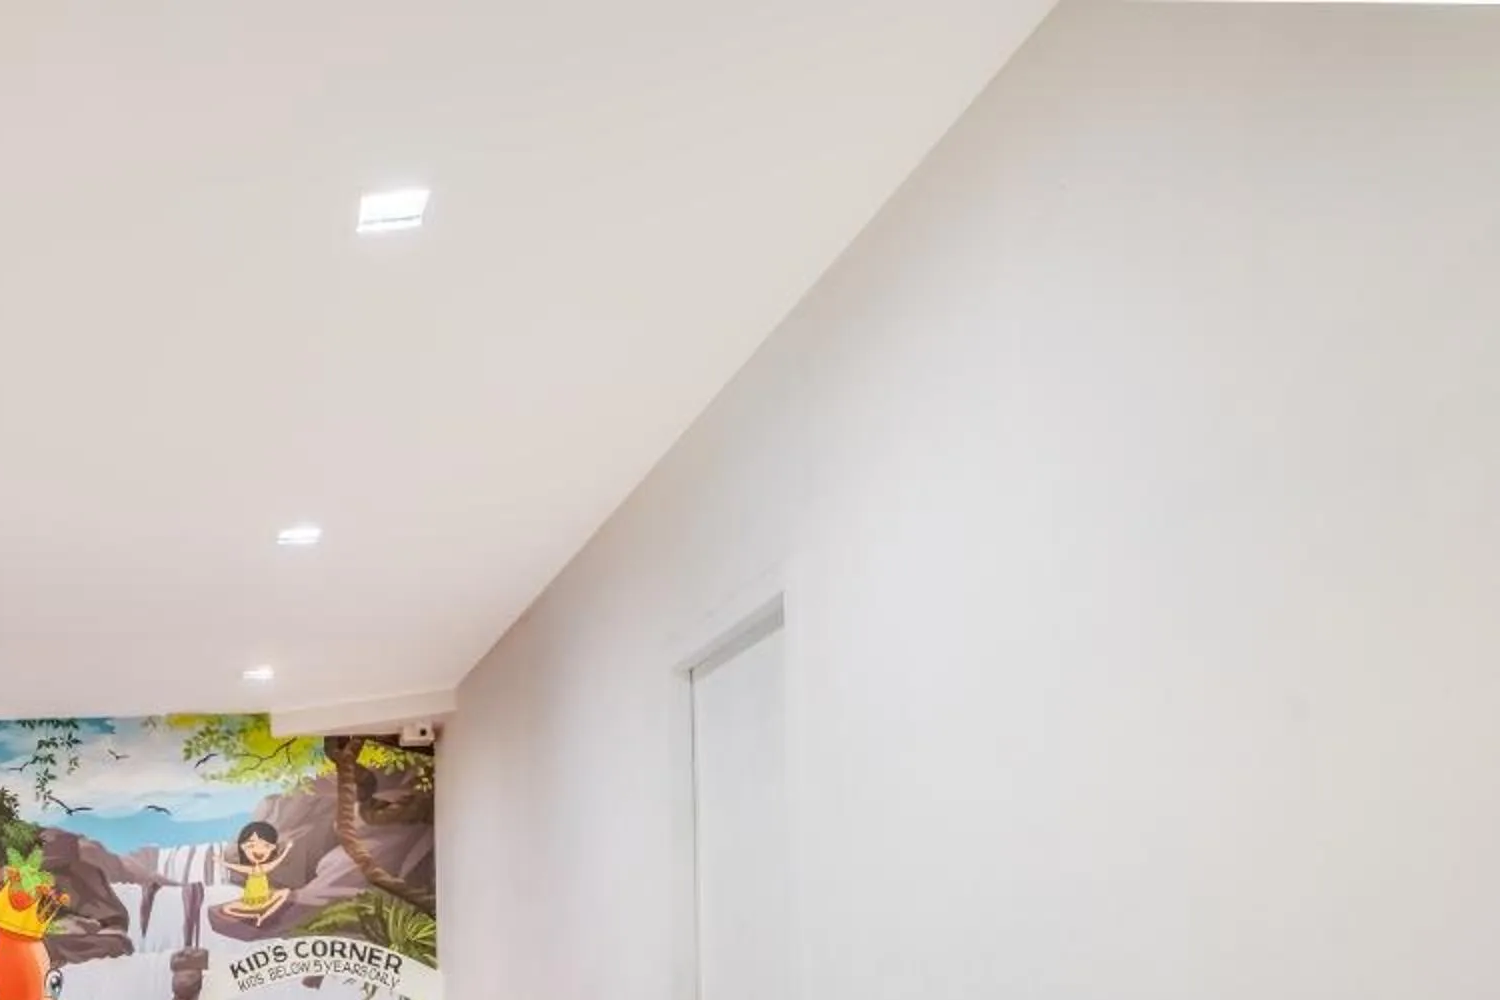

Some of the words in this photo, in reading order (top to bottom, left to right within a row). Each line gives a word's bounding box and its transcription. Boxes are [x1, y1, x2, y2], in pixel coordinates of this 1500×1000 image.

[230, 945, 287, 979] KID'S
[295, 940, 403, 973] CORNER
[237, 974, 264, 992] KIDS
[269, 961, 311, 981] BELOW
[325, 960, 367, 977] YEARS
